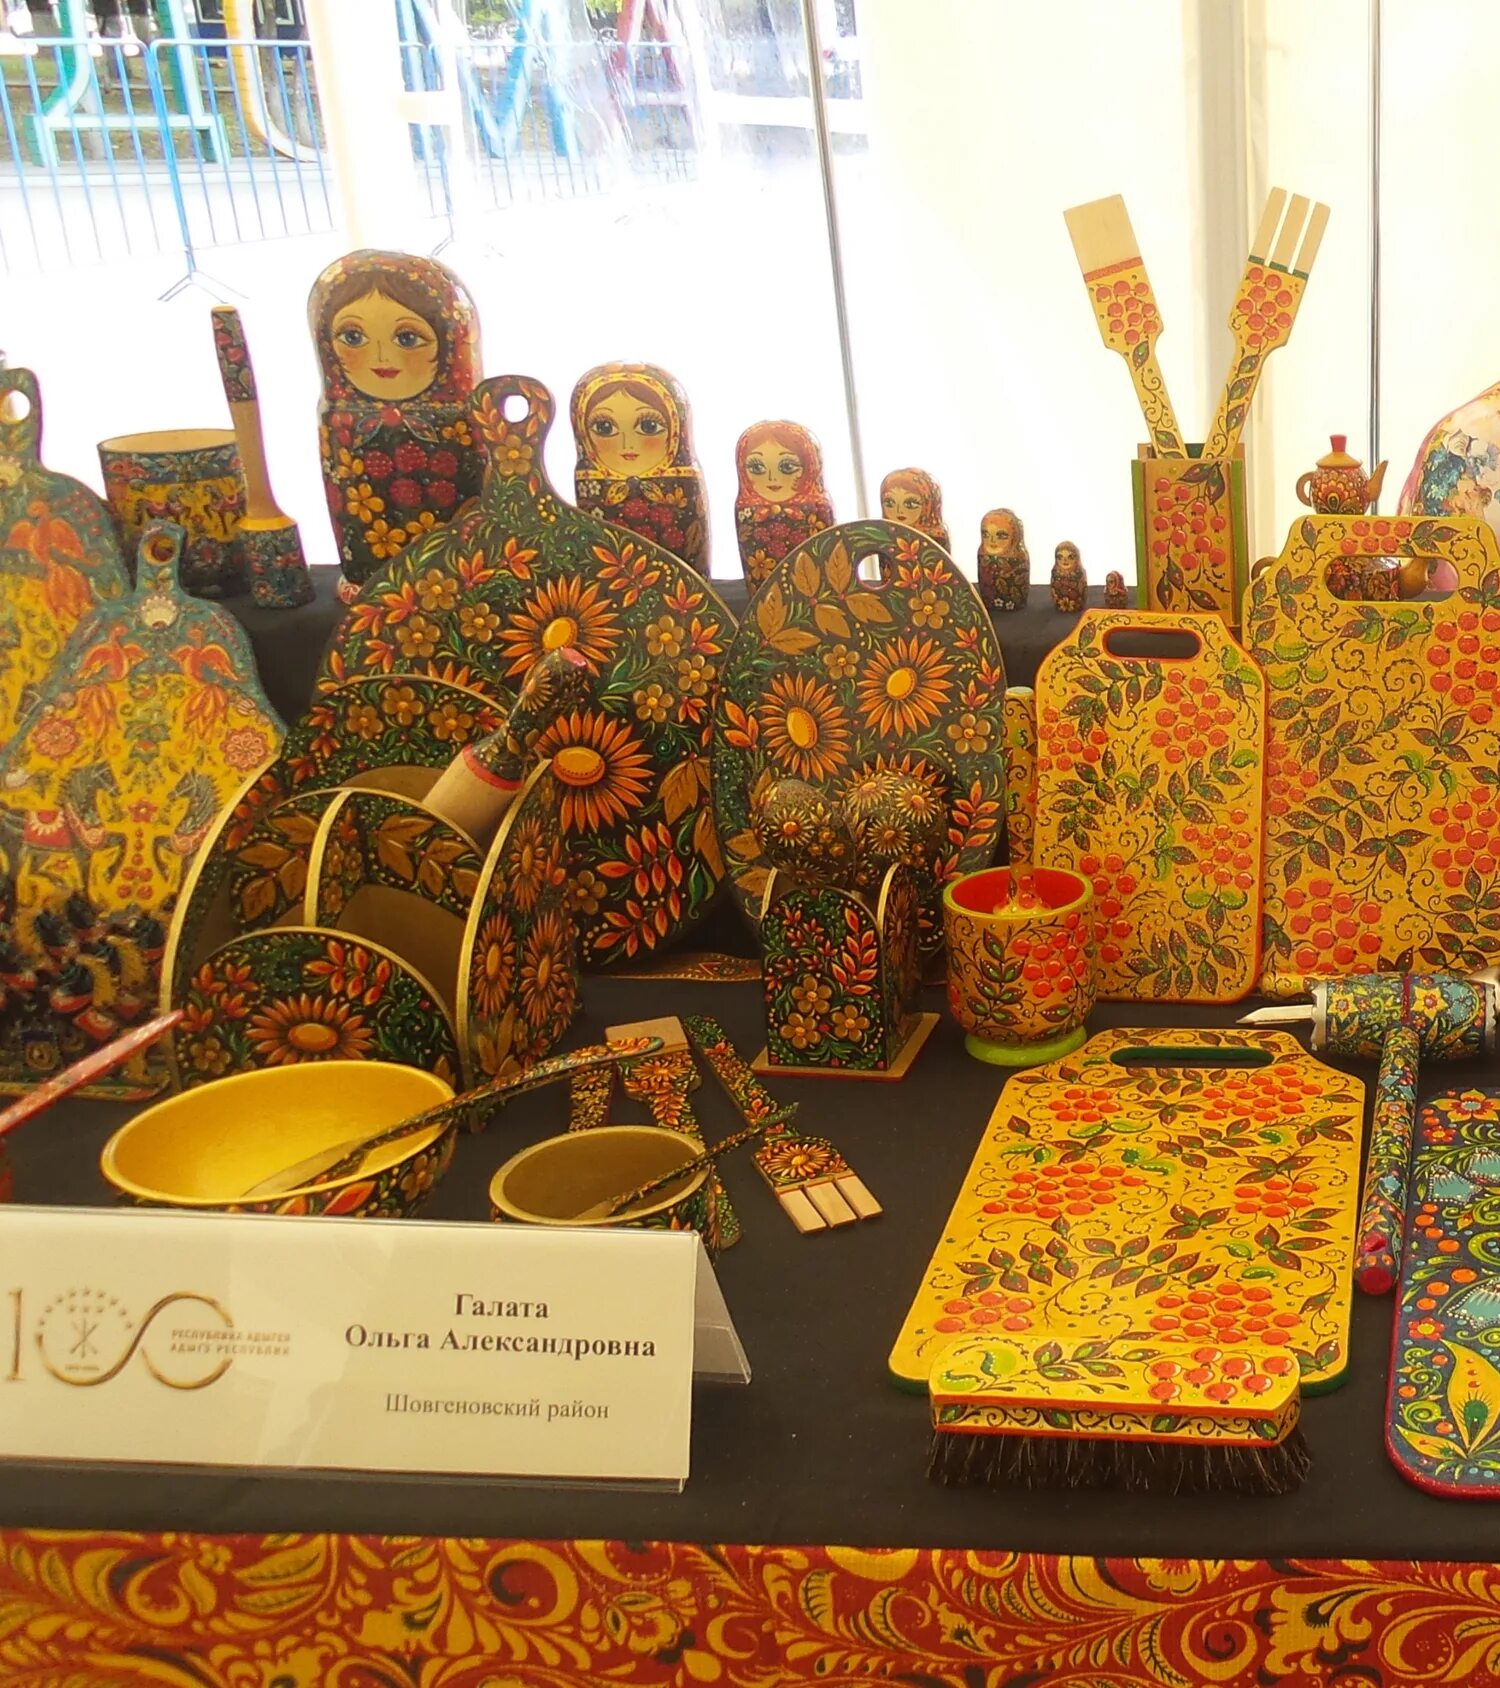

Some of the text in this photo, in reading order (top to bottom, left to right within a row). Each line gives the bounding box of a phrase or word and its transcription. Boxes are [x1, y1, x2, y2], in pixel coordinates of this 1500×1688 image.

[454, 1293, 549, 1318] Галата
[171, 1329, 291, 1343] РЕСПУБЛИКА АДЫГЕЯ
[344, 1324, 656, 1361] Ольга Александровна
[385, 1393, 610, 1422] Шовгеновский район
